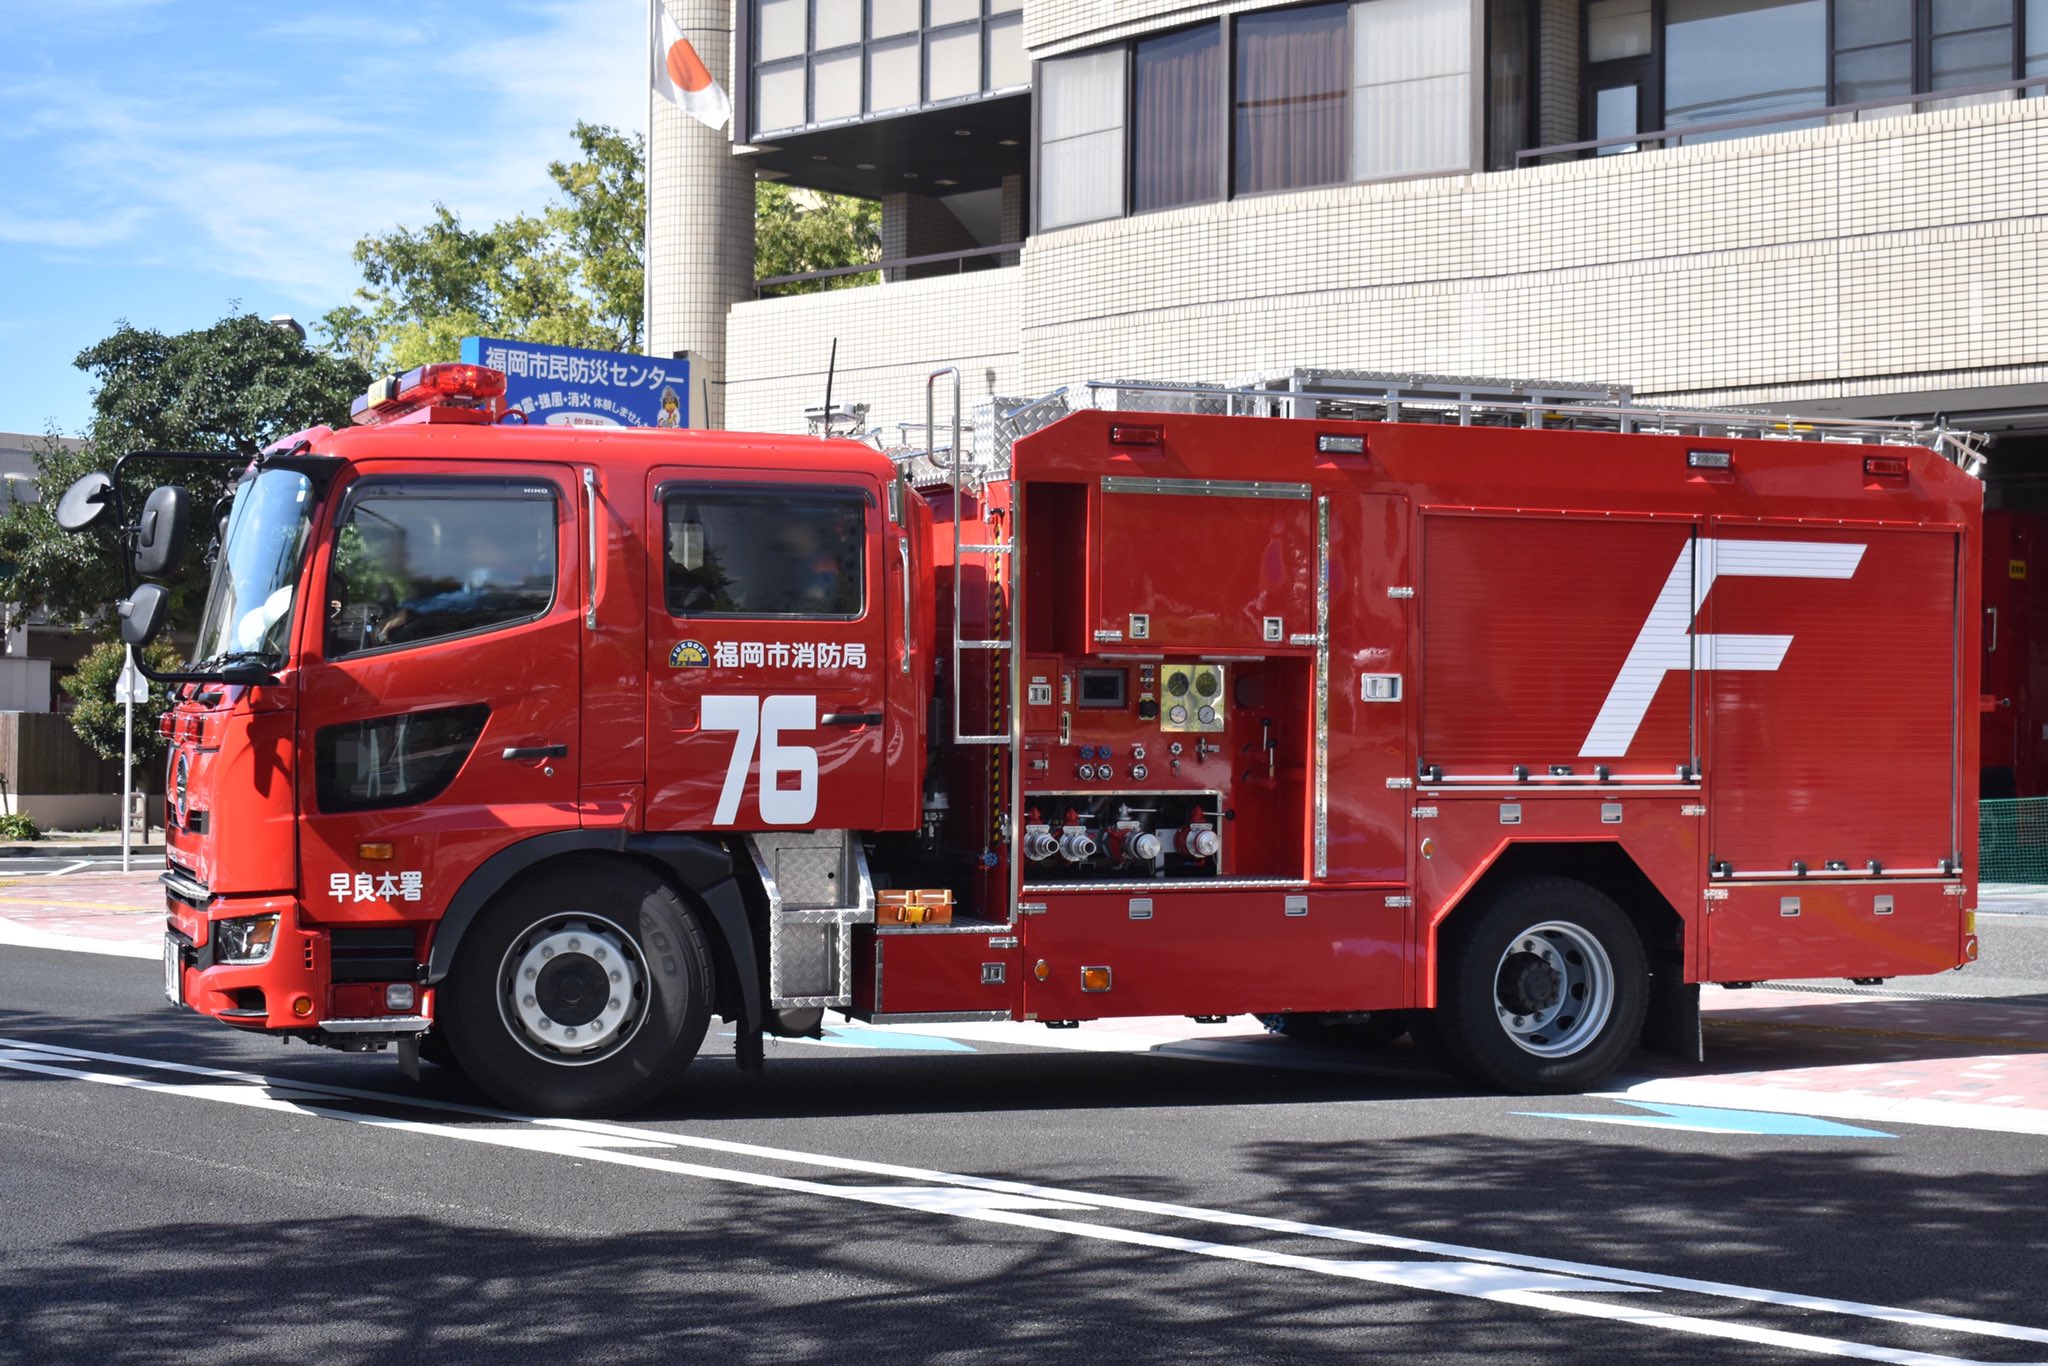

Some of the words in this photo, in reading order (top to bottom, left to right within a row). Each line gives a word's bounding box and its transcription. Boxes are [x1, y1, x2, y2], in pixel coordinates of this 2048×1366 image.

[486, 346, 684, 390] 福岡市民防災センター
[672, 641, 707, 659] FUKUOKA
[713, 640, 867, 669] 福岡市消防局
[1577, 537, 1868, 758] F
[700, 695, 819, 825] 76
[328, 870, 423, 903] 早良本署
